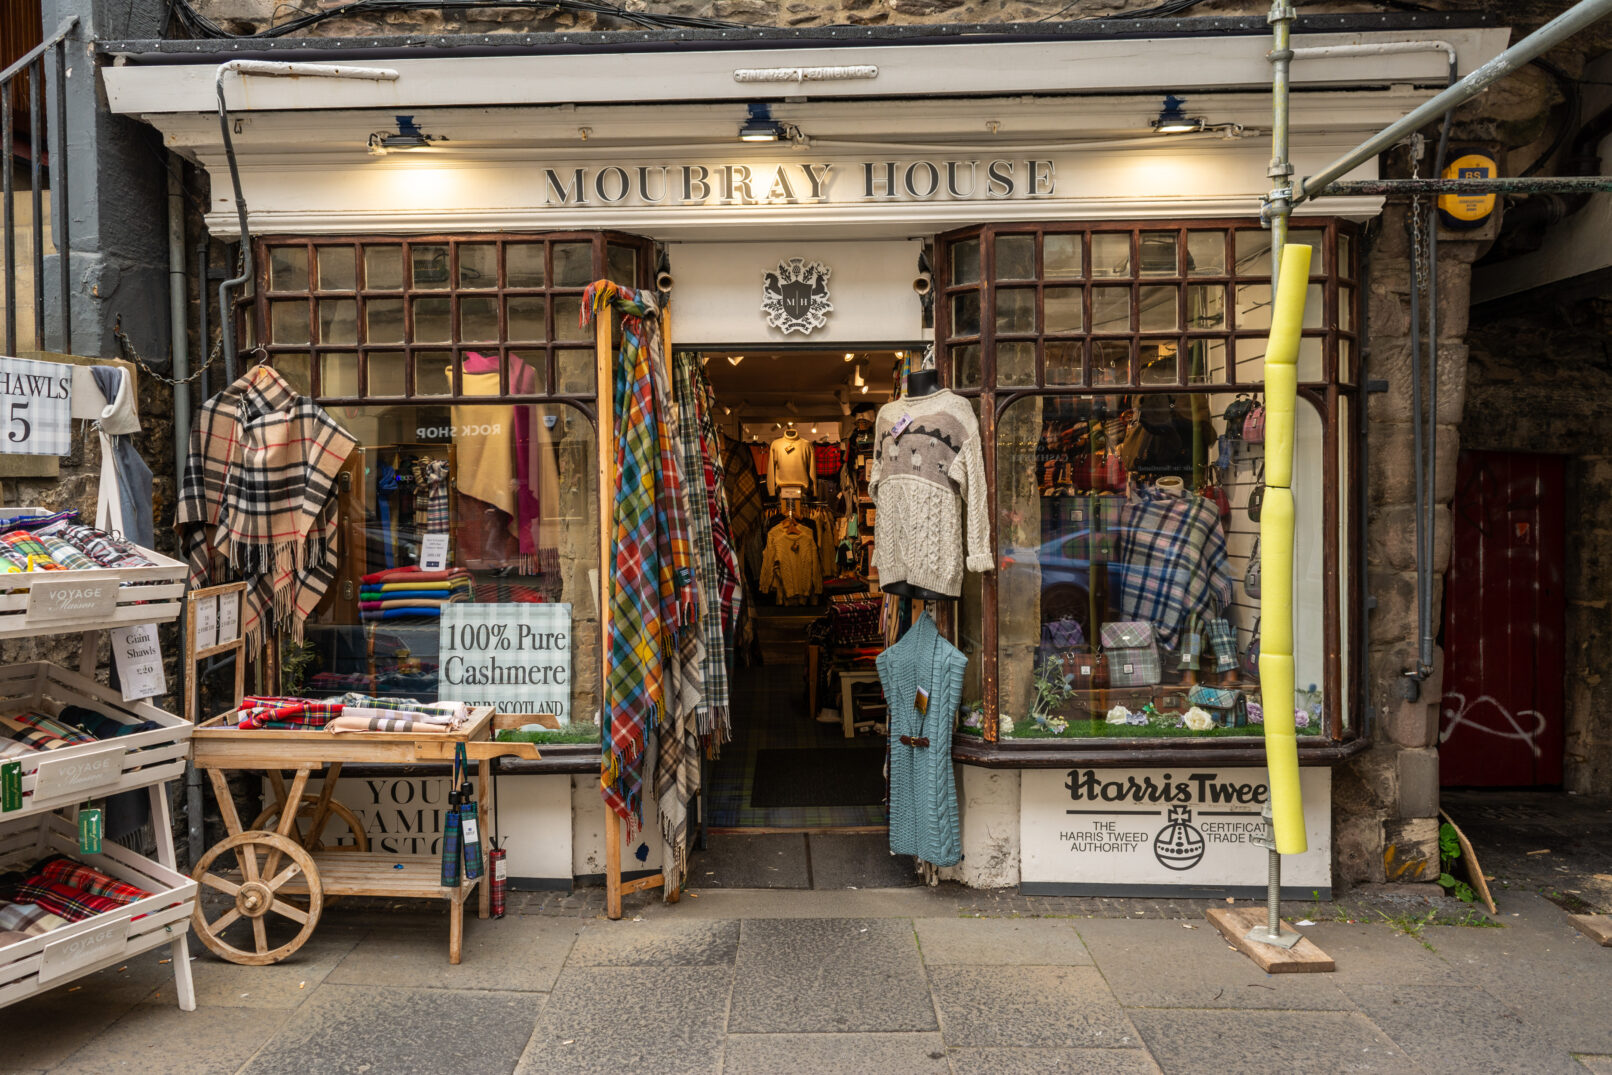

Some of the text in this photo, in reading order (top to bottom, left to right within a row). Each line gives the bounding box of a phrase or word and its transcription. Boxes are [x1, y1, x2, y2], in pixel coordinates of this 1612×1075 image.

[544, 159, 1057, 205] MOUBRAY HOUSE
[49, 588, 102, 600] VOYAGE
[126, 633, 151, 645] Giant
[447, 623, 566, 651] 100% Pure
[127, 646, 156, 659] Shawls
[444, 655, 566, 686] Cashmere
[497, 700, 564, 717] SCOTLAND
[58, 758, 112, 777] VOYAGE
[366, 779, 453, 804] YOU
[1092, 821, 1116, 831] THE
[1060, 831, 1149, 842] HARRIS TWEED
[1207, 833, 1245, 843] TRADE
[1070, 842, 1138, 853] AUTHORITY
[62, 929, 114, 954] VOYAGE
